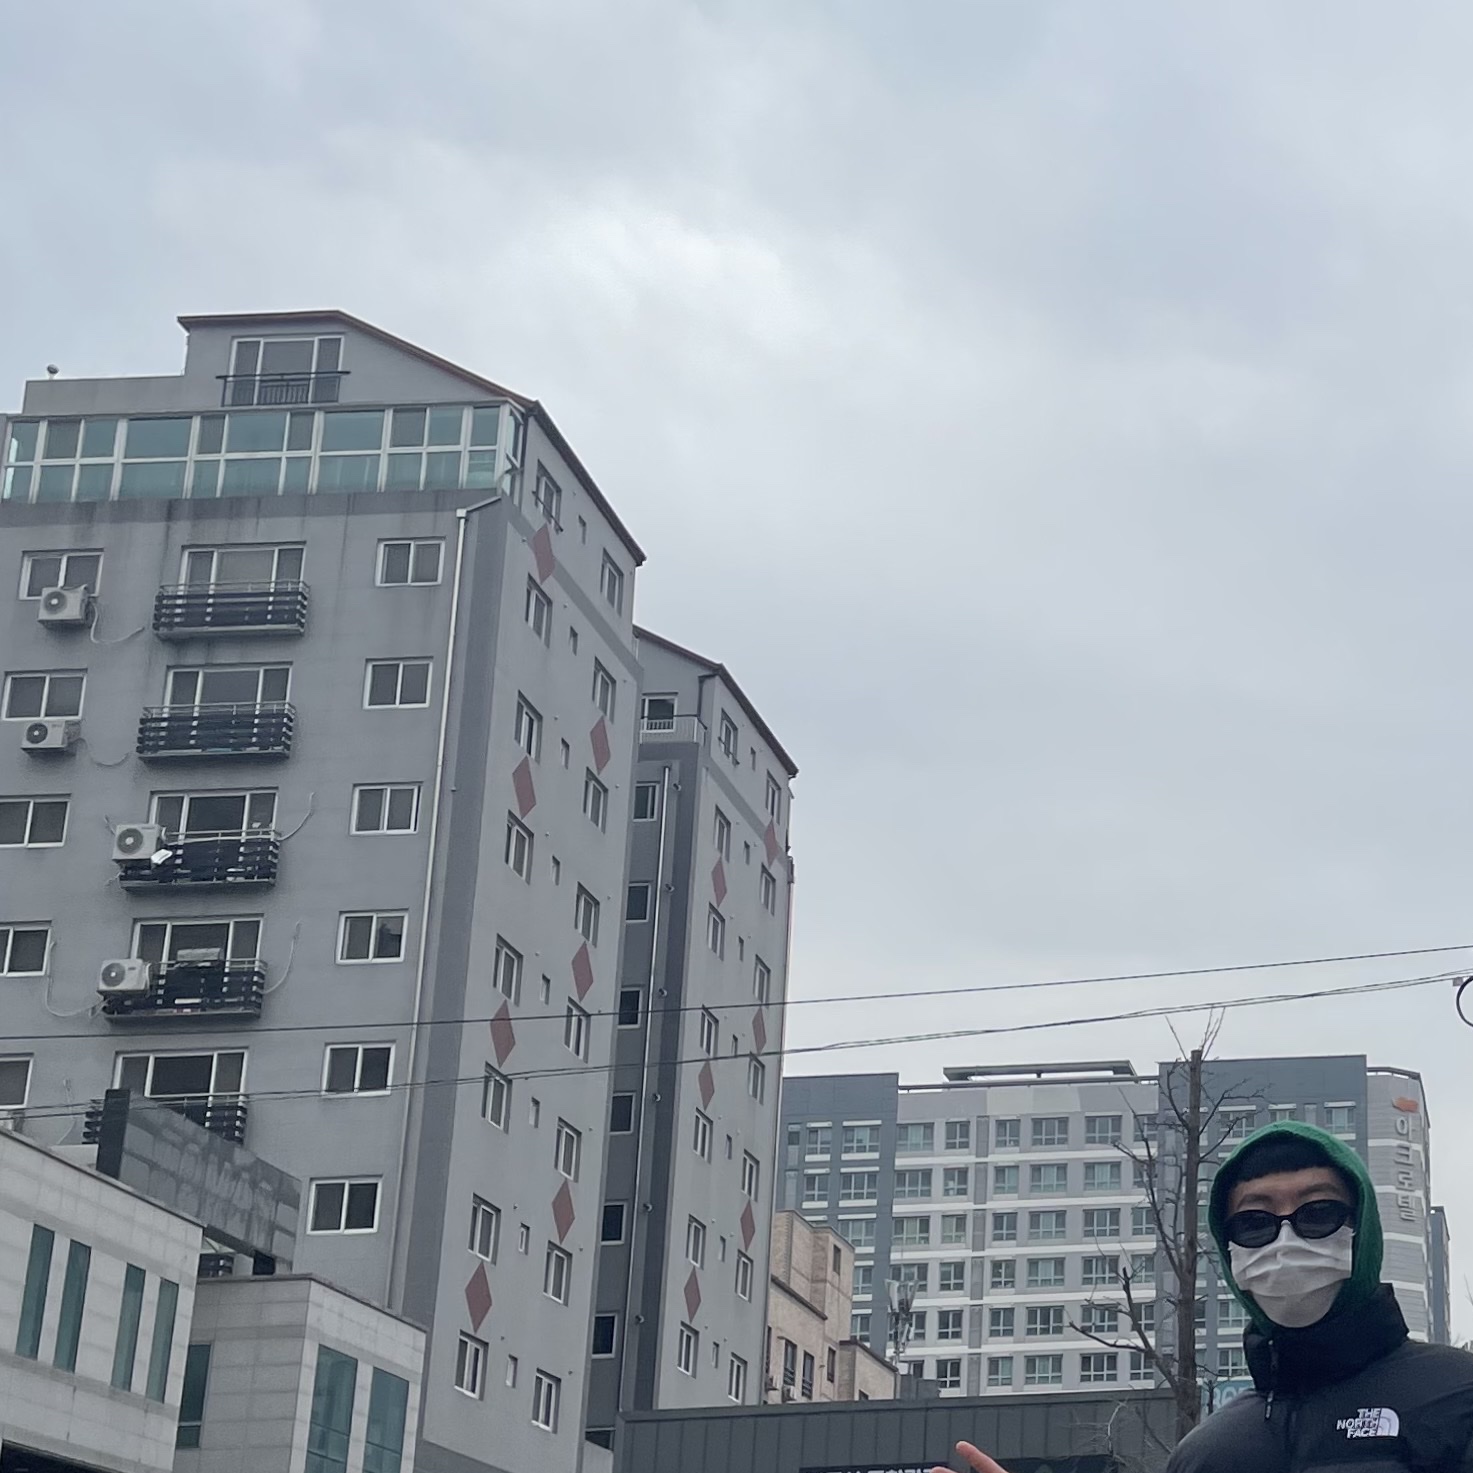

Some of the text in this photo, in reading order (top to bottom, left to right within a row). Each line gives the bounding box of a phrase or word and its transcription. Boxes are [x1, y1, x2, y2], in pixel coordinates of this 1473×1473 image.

[1357, 1408, 1380, 1418] THE
[1336, 1418, 1379, 1430] NORTH
[1347, 1428, 1377, 1438] FACE
